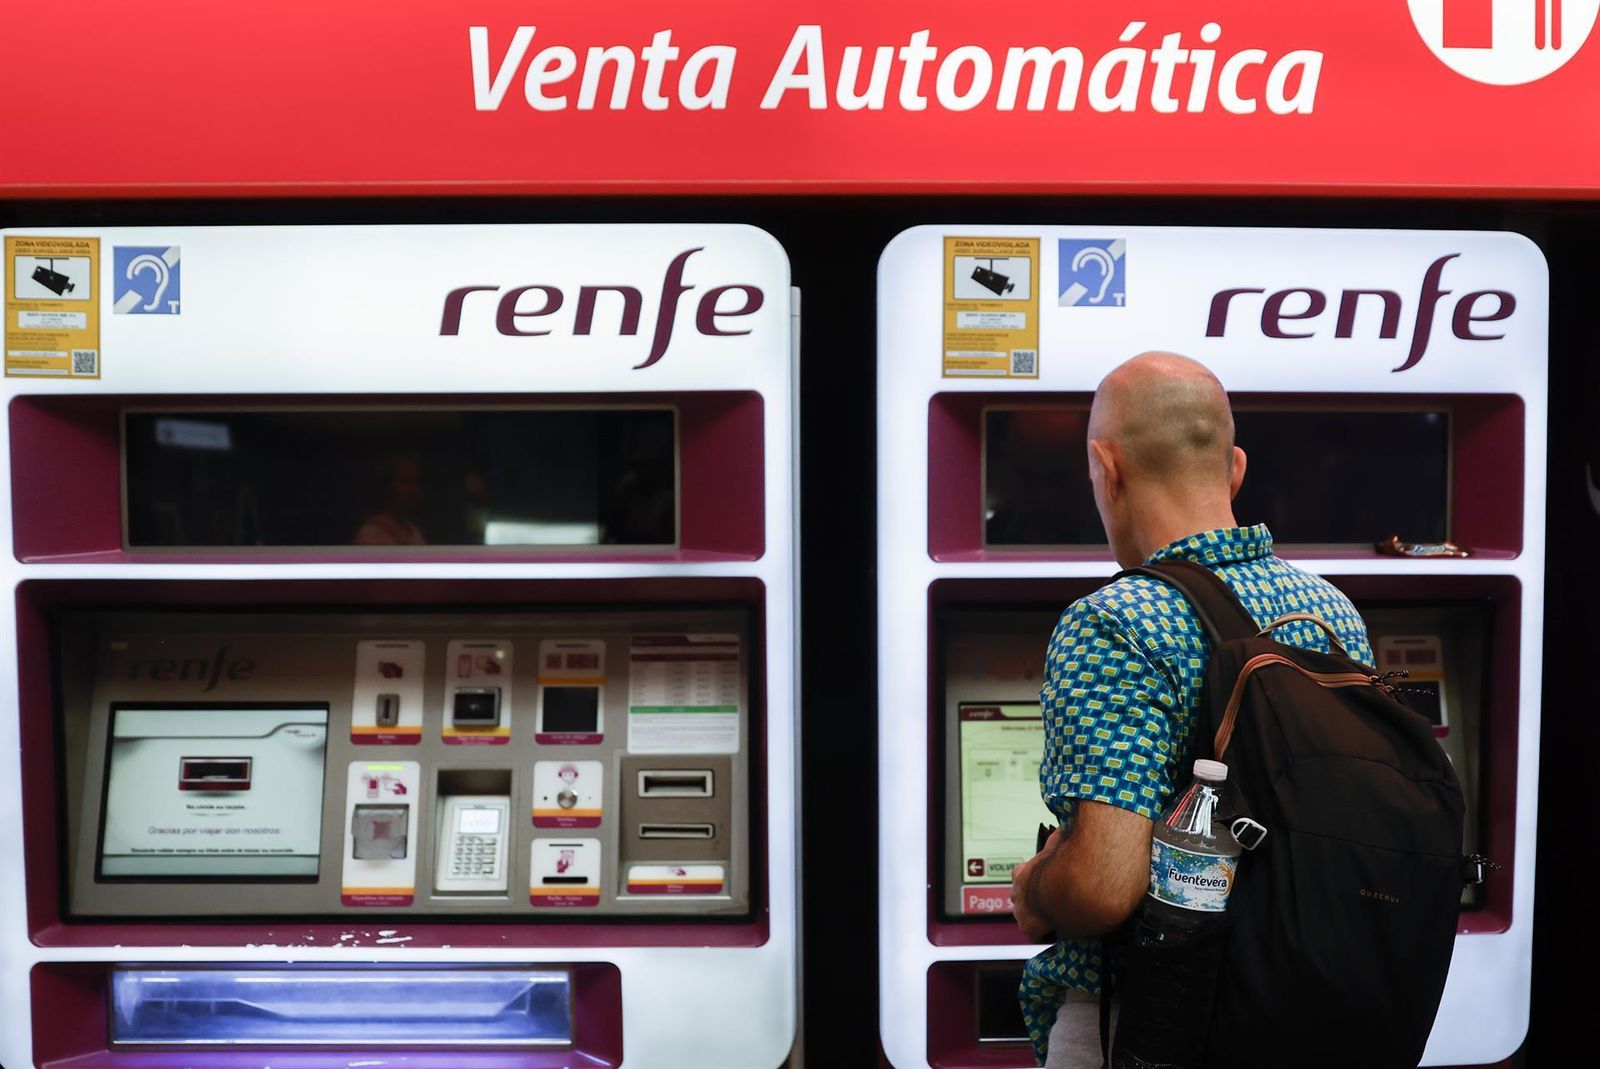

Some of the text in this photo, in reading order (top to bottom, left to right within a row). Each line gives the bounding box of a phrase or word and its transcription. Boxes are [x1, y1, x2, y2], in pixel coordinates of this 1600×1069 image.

[469, 22, 1324, 115] Venta Automática
[168, 300, 179, 313] T
[439, 247, 764, 370] renfe
[1113, 293, 1125, 306] T
[1205, 253, 1516, 372] renfe
[128, 644, 255, 692] renfe
[148, 826, 181, 836] Gracias
[182, 828, 197, 838] por
[1168, 868, 1227, 888] Fuentevera
[969, 895, 1003, 913] Pago
